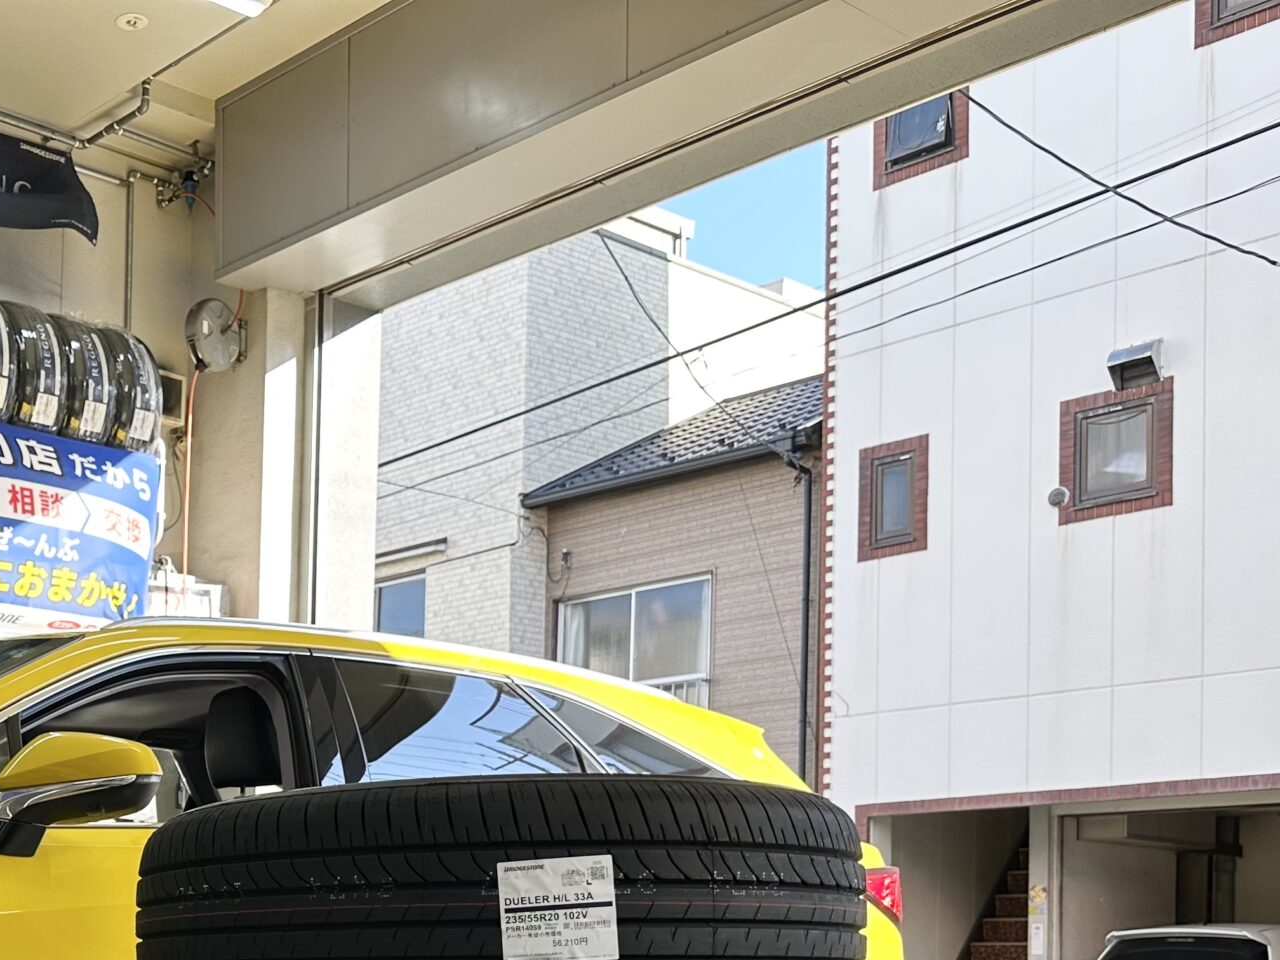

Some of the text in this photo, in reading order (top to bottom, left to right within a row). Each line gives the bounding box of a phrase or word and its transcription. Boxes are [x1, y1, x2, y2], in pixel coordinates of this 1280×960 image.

[36, 324, 52, 368] REGNO
[82, 335, 100, 377] REGNO
[7, 483, 67, 519] 相談
[504, 891, 594, 906] DUELER H/L 33A
[505, 910, 588, 924] 235/55R20 102V
[505, 924, 542, 933] PSR14059
